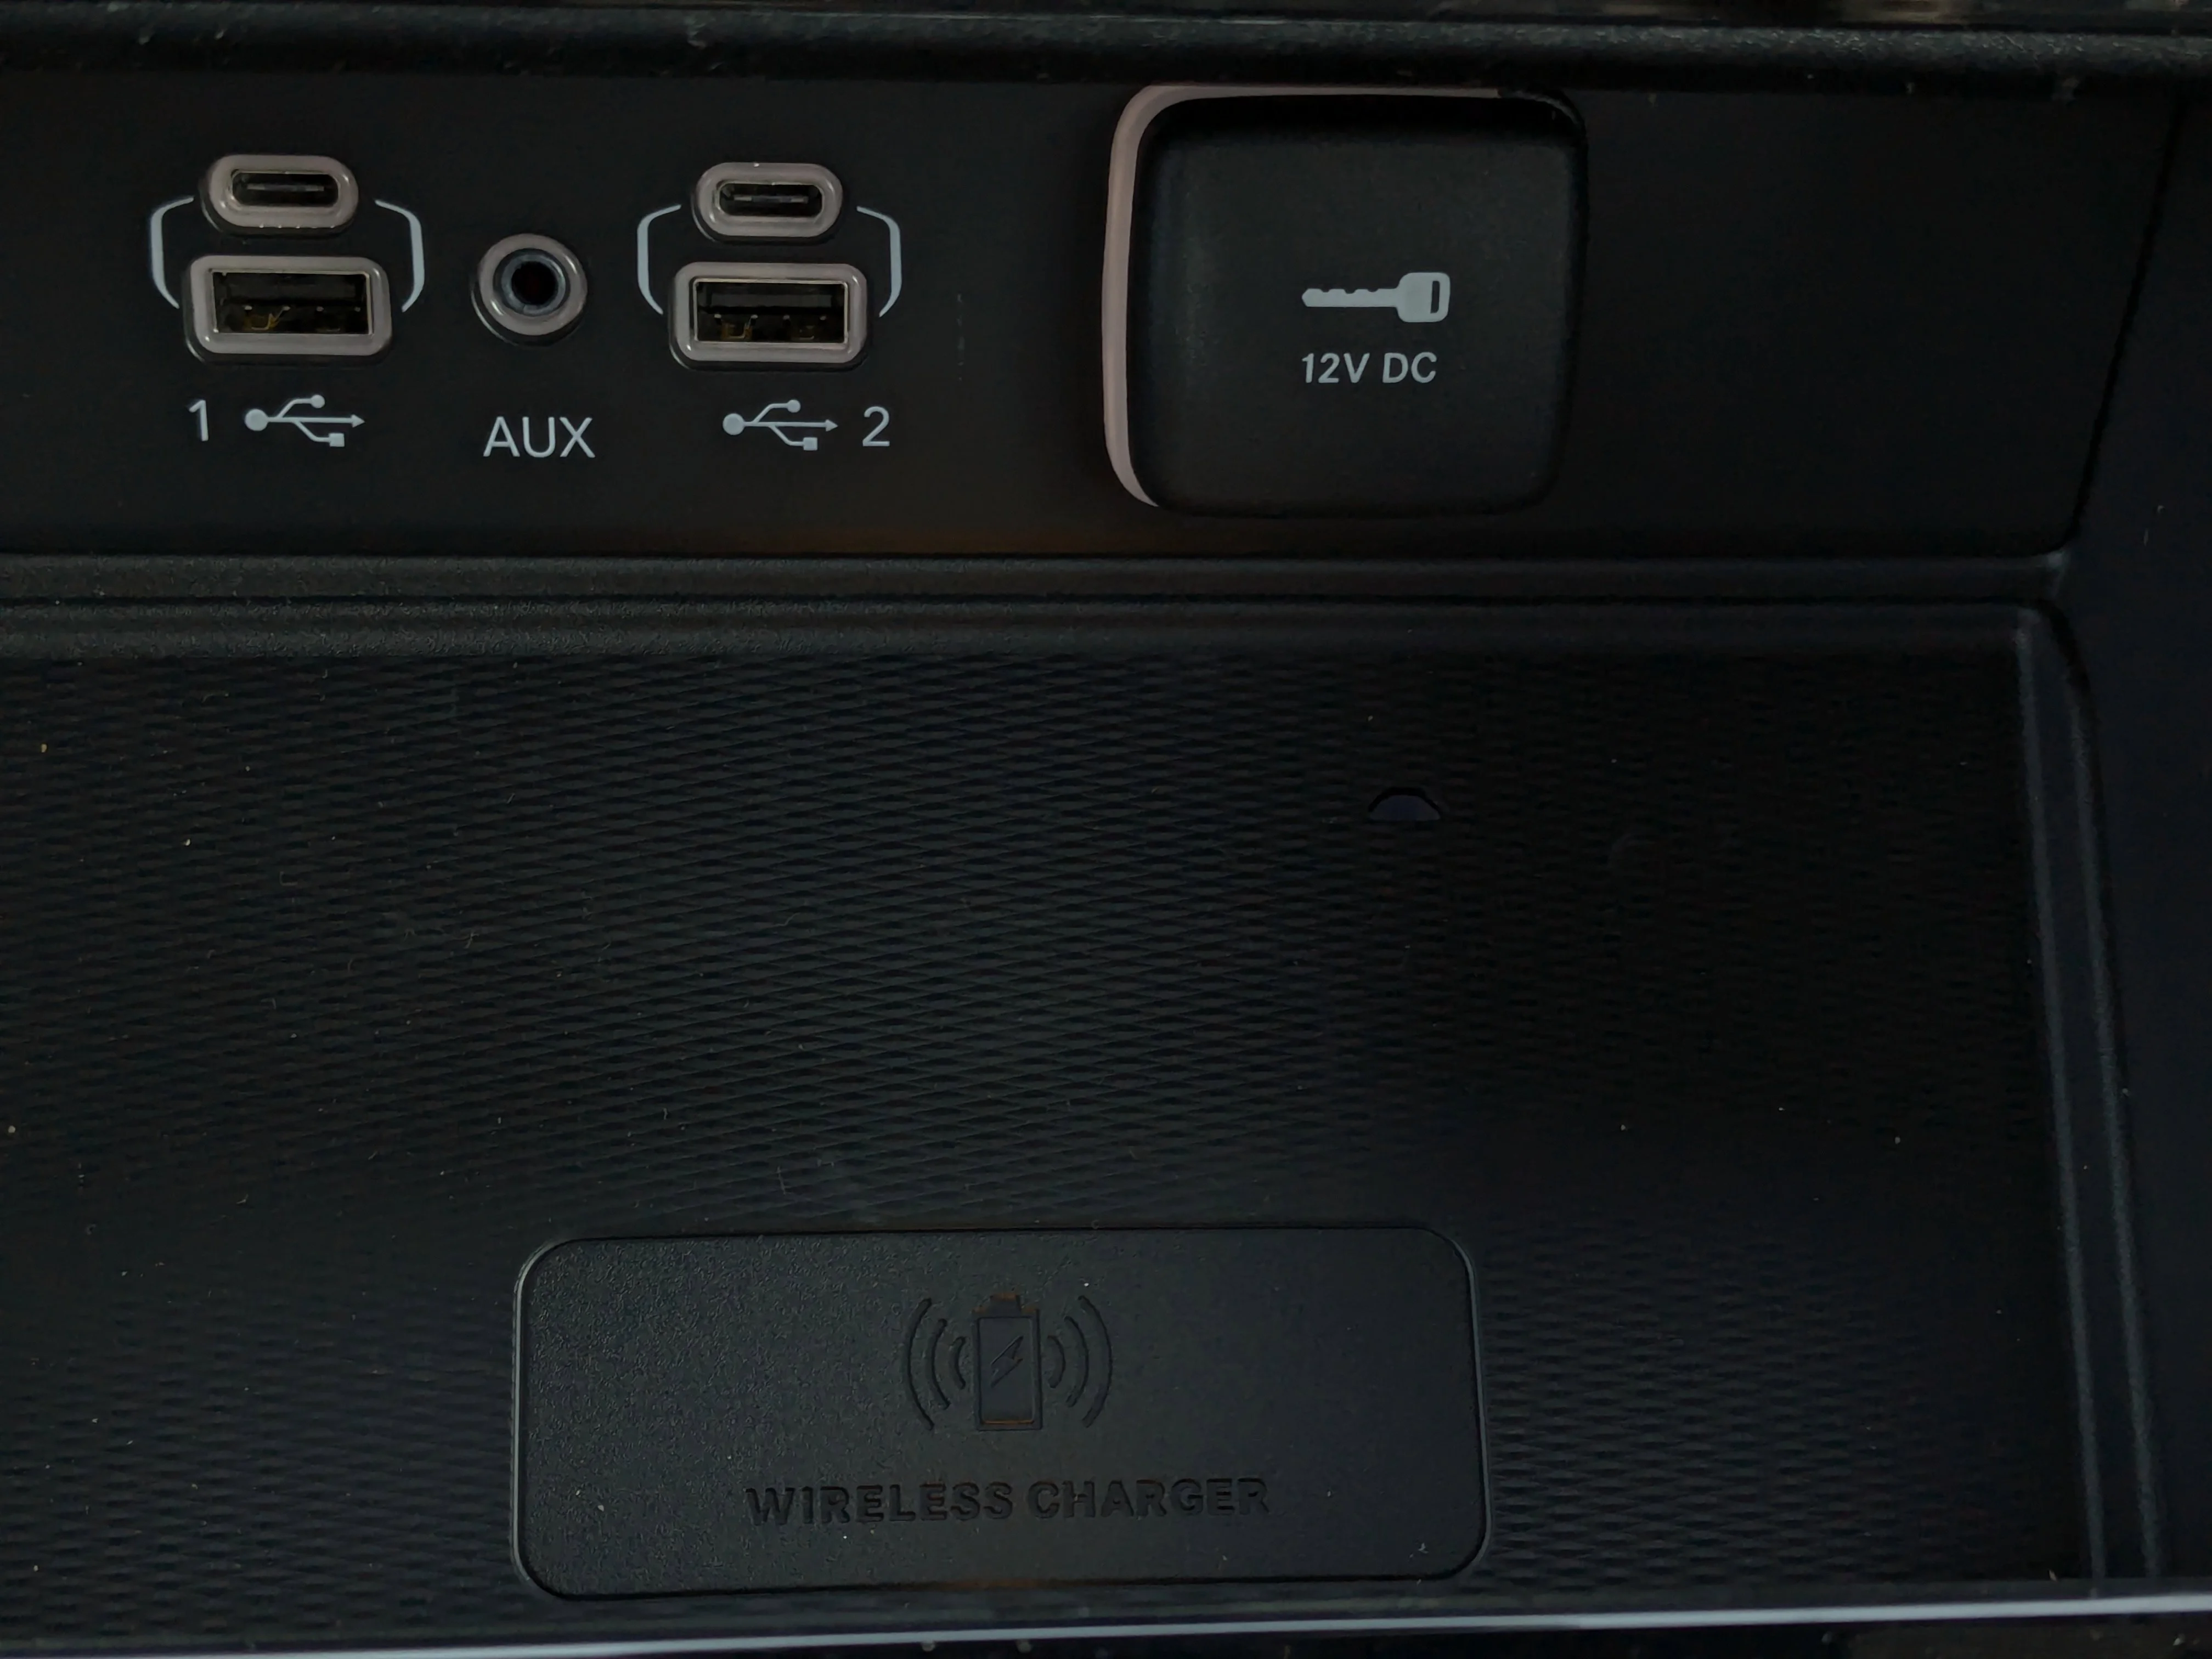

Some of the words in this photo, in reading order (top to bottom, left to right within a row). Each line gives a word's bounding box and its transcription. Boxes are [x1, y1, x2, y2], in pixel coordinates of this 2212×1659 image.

[1302, 353, 1370, 383] 12V
[1383, 352, 1437, 383] DC
[189, 399, 208, 441] 1
[483, 416, 595, 458] AUX
[862, 406, 890, 447] 2
[745, 1481, 1014, 1526] WIRELESS
[1027, 1477, 1271, 1519] CHARGER
